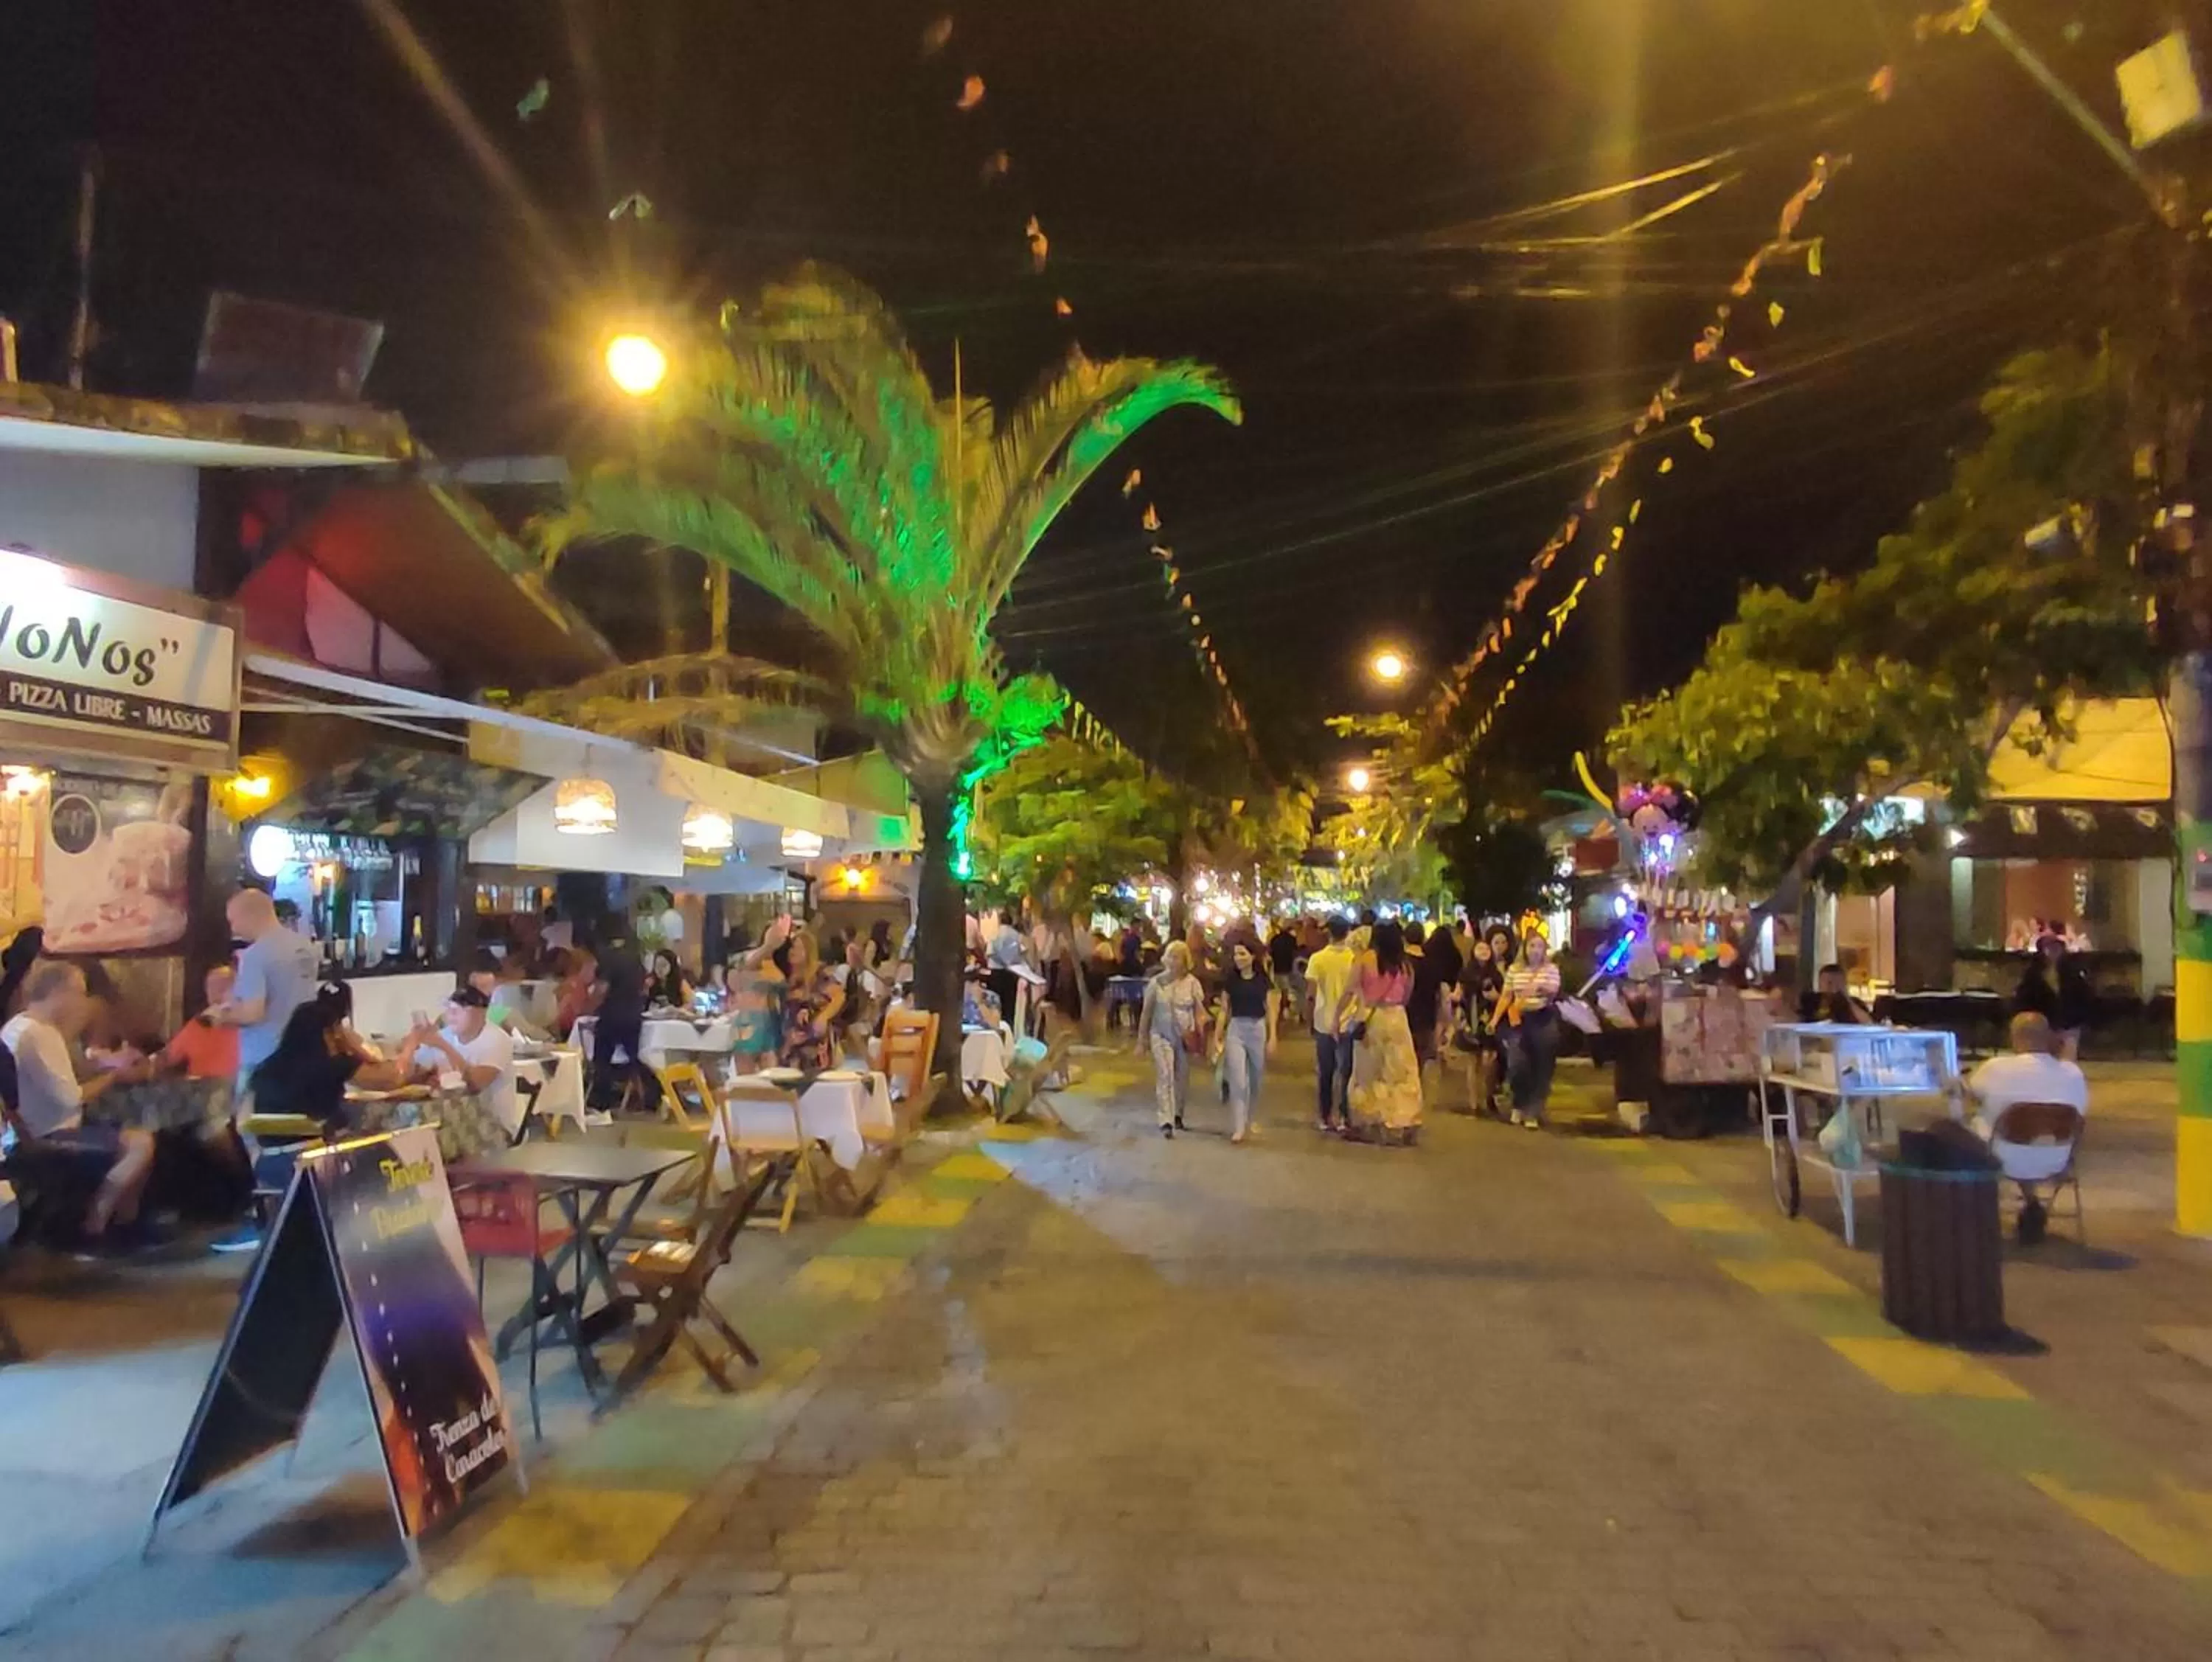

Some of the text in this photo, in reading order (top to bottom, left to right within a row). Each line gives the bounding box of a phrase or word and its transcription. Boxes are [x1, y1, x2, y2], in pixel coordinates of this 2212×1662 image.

[0, 605, 179, 686] oNos"
[9, 681, 68, 712] PIZZA
[74, 692, 126, 720] LIBRE
[147, 705, 212, 734] MASSAS
